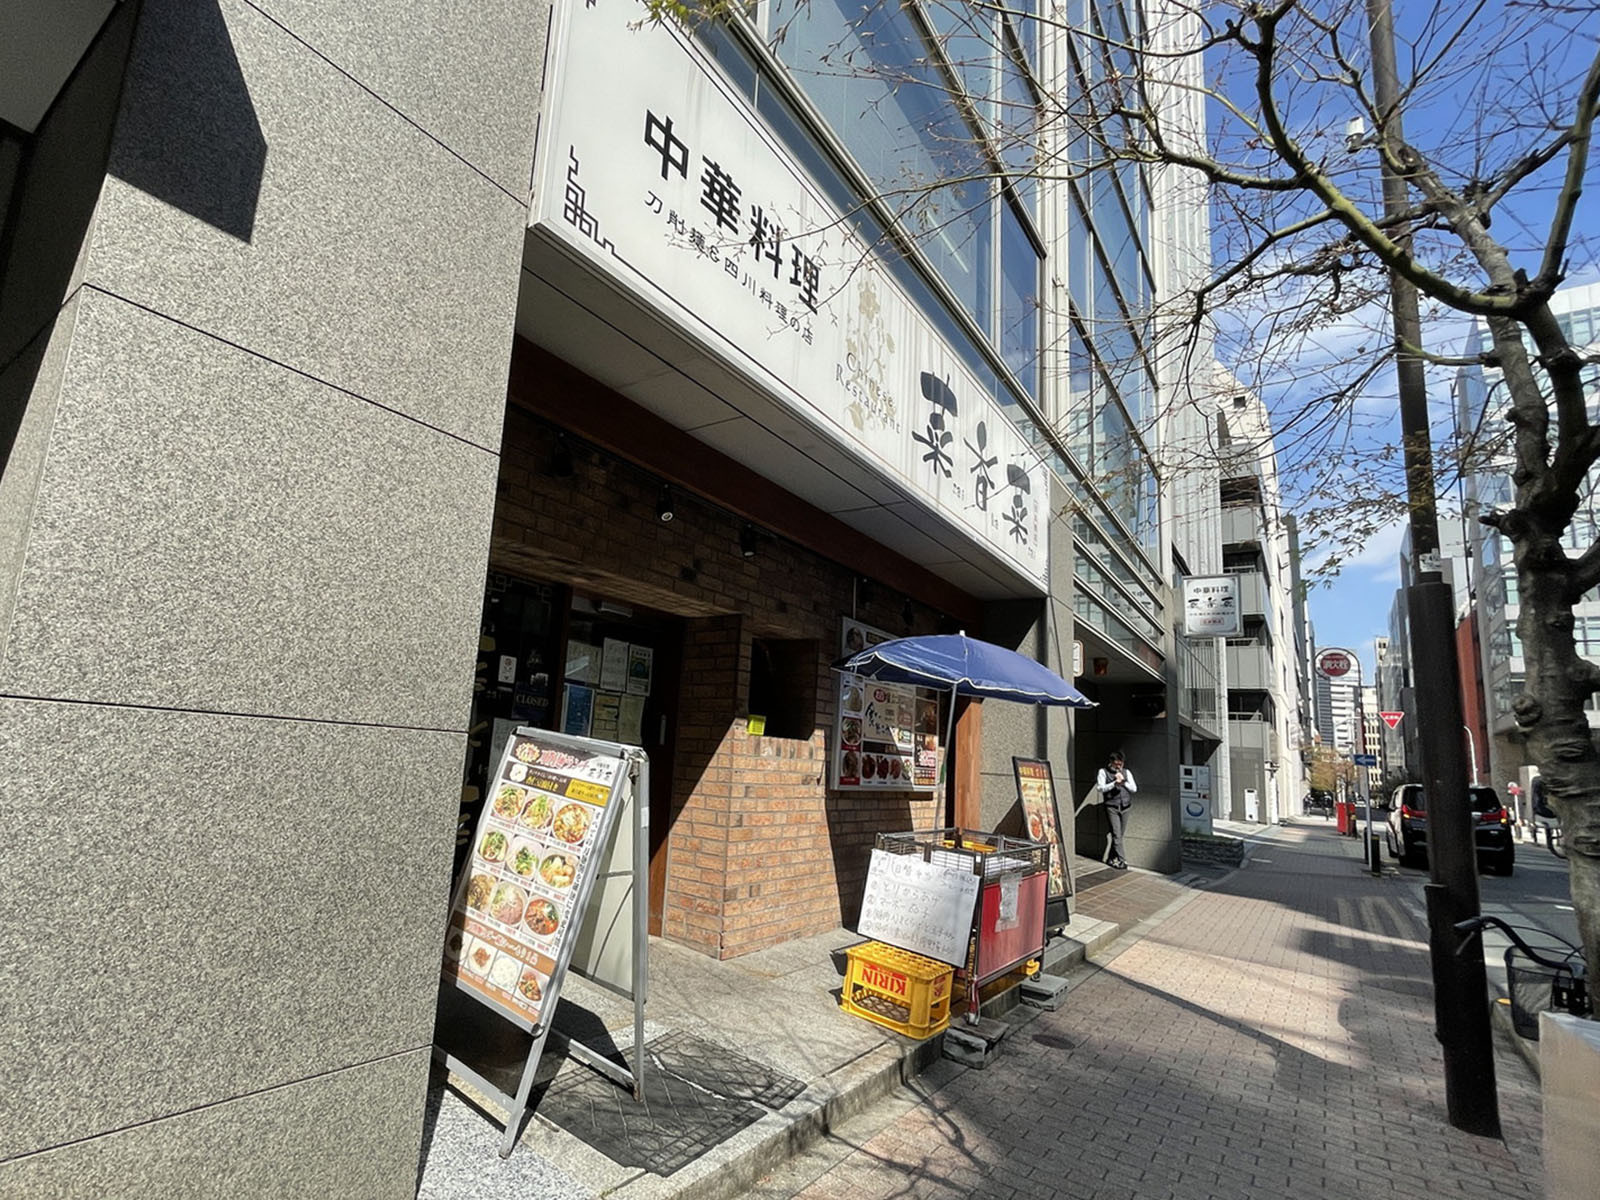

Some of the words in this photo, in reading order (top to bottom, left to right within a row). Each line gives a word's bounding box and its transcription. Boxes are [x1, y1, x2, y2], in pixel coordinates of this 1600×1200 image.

[644, 109, 819, 316] 中華料理
[835, 363, 901, 434] Restaurant
[846, 351, 897, 408] Chinese
[516, 694, 549, 707] CLOSED
[862, 967, 907, 996] KIRIN
